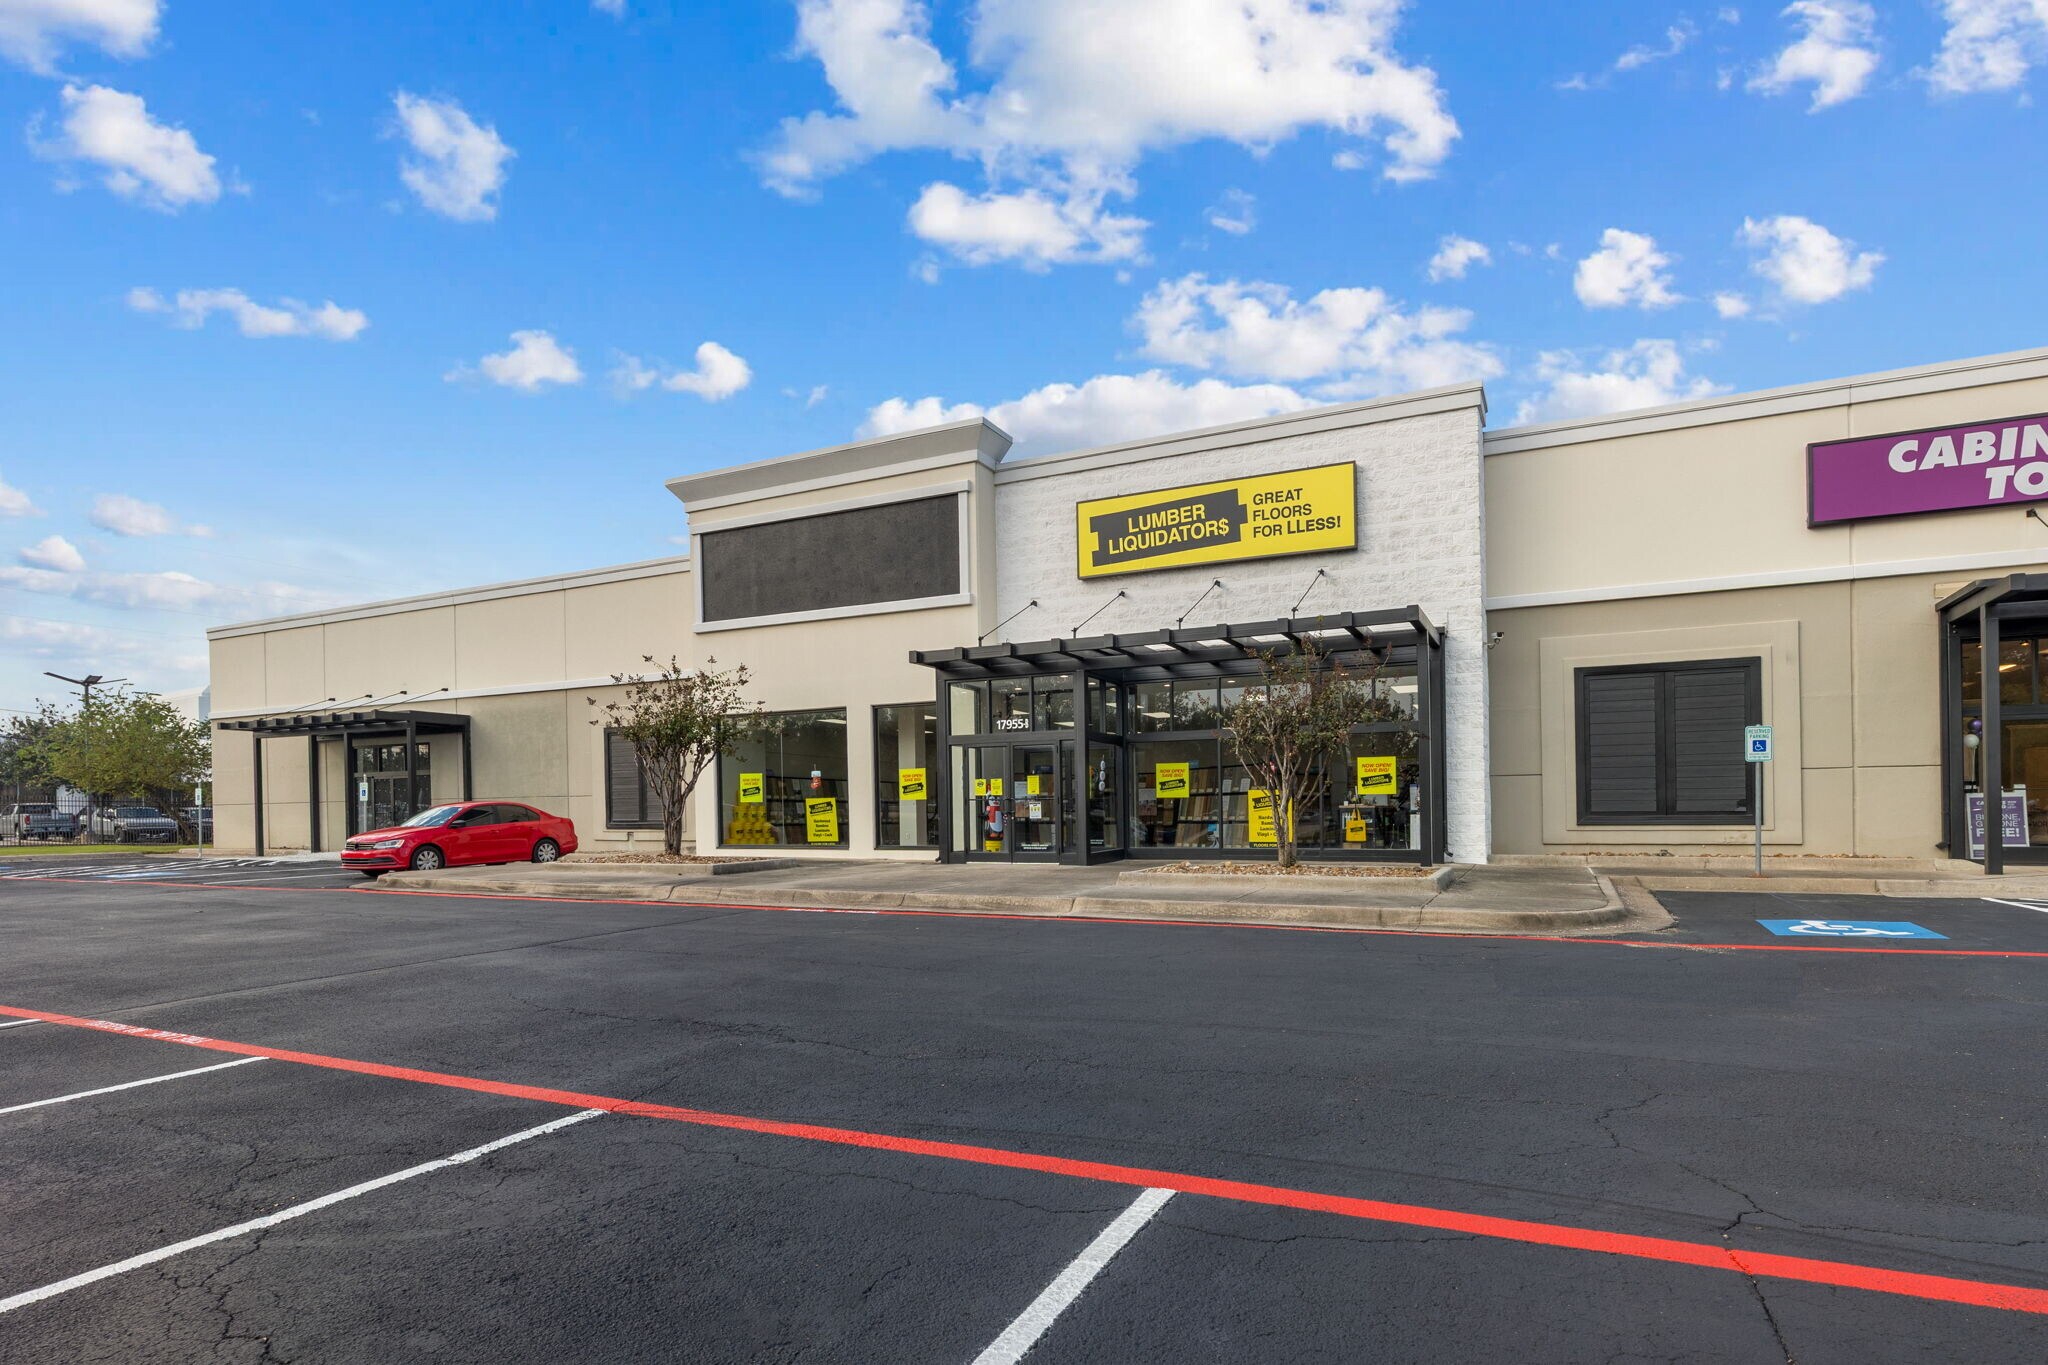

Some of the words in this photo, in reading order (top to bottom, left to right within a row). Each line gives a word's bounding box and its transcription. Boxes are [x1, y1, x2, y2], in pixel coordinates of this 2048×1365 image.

[1888, 424, 2048, 473] CABIN
[1985, 461, 2048, 500] TO
[1252, 488, 1303, 506] GREAT
[1127, 503, 1206, 533] LUMBER
[1253, 503, 1312, 522] FLOORS
[1253, 522, 1283, 538] FOR
[1287, 516, 1341, 535] LLESS!
